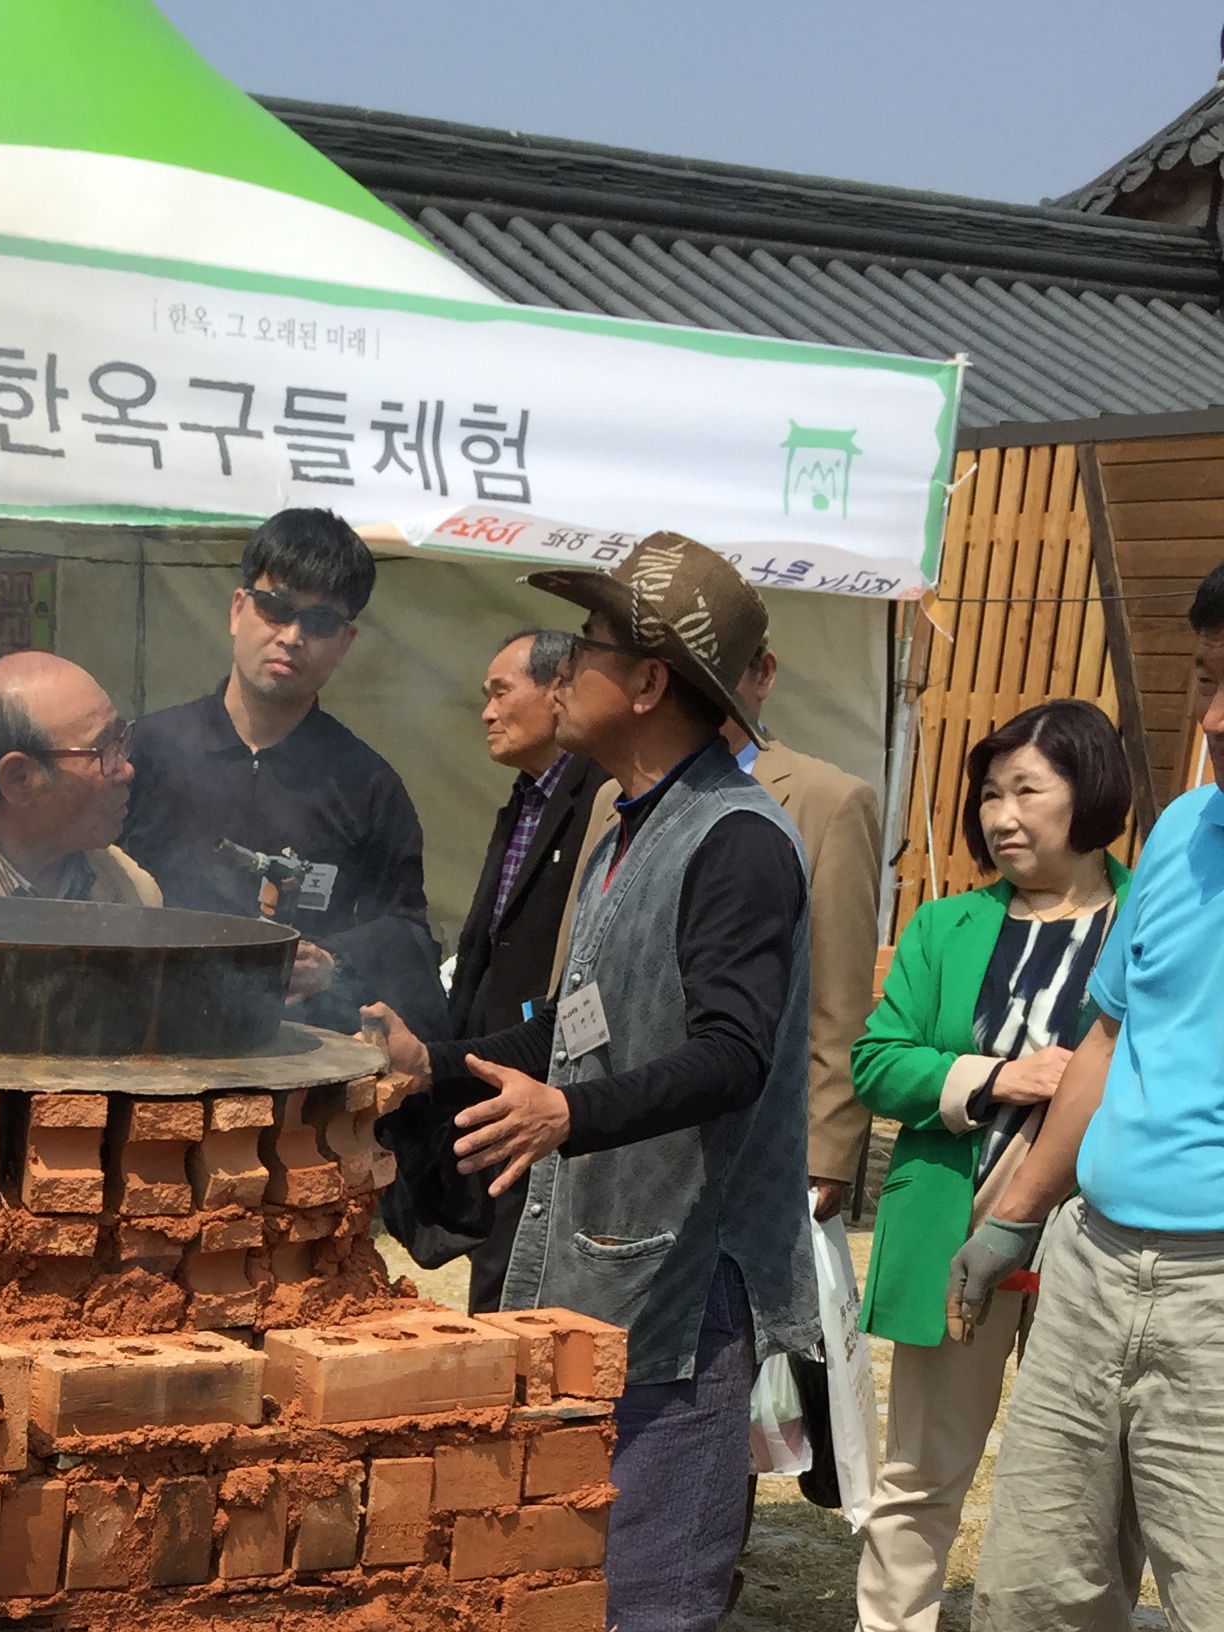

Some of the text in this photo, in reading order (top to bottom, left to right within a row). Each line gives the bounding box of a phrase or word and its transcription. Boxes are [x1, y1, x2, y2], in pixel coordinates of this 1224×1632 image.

[168, 303, 367, 358] 한옥, 그 오래된 미래
